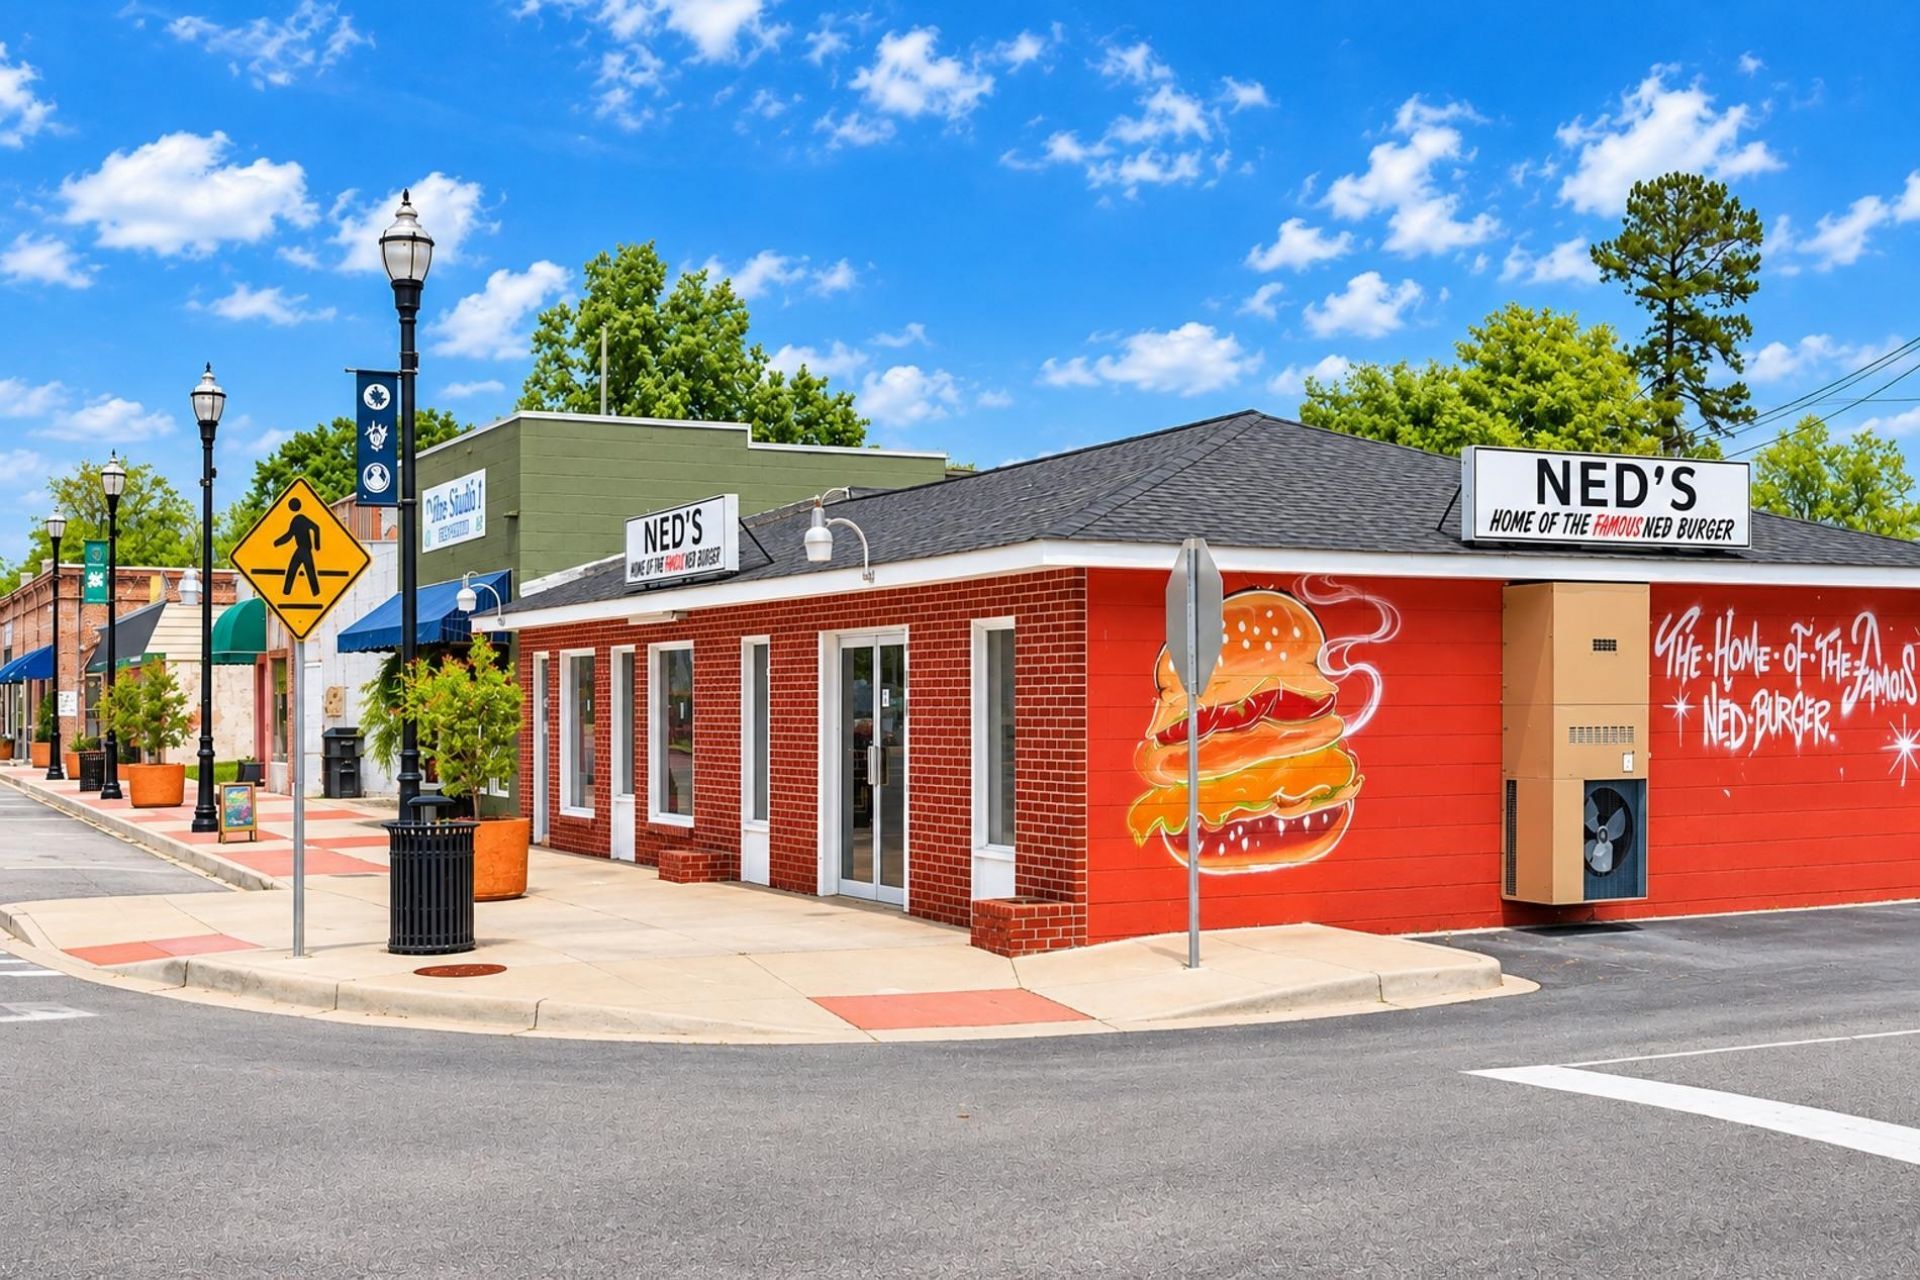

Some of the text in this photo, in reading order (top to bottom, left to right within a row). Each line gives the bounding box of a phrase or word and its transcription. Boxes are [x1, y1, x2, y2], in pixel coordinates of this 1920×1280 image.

[1536, 458, 1697, 511] NED'S
[644, 508, 703, 554] NED'S
[1490, 509, 1735, 541] HOME OF THE FAMOUS NED BURGER
